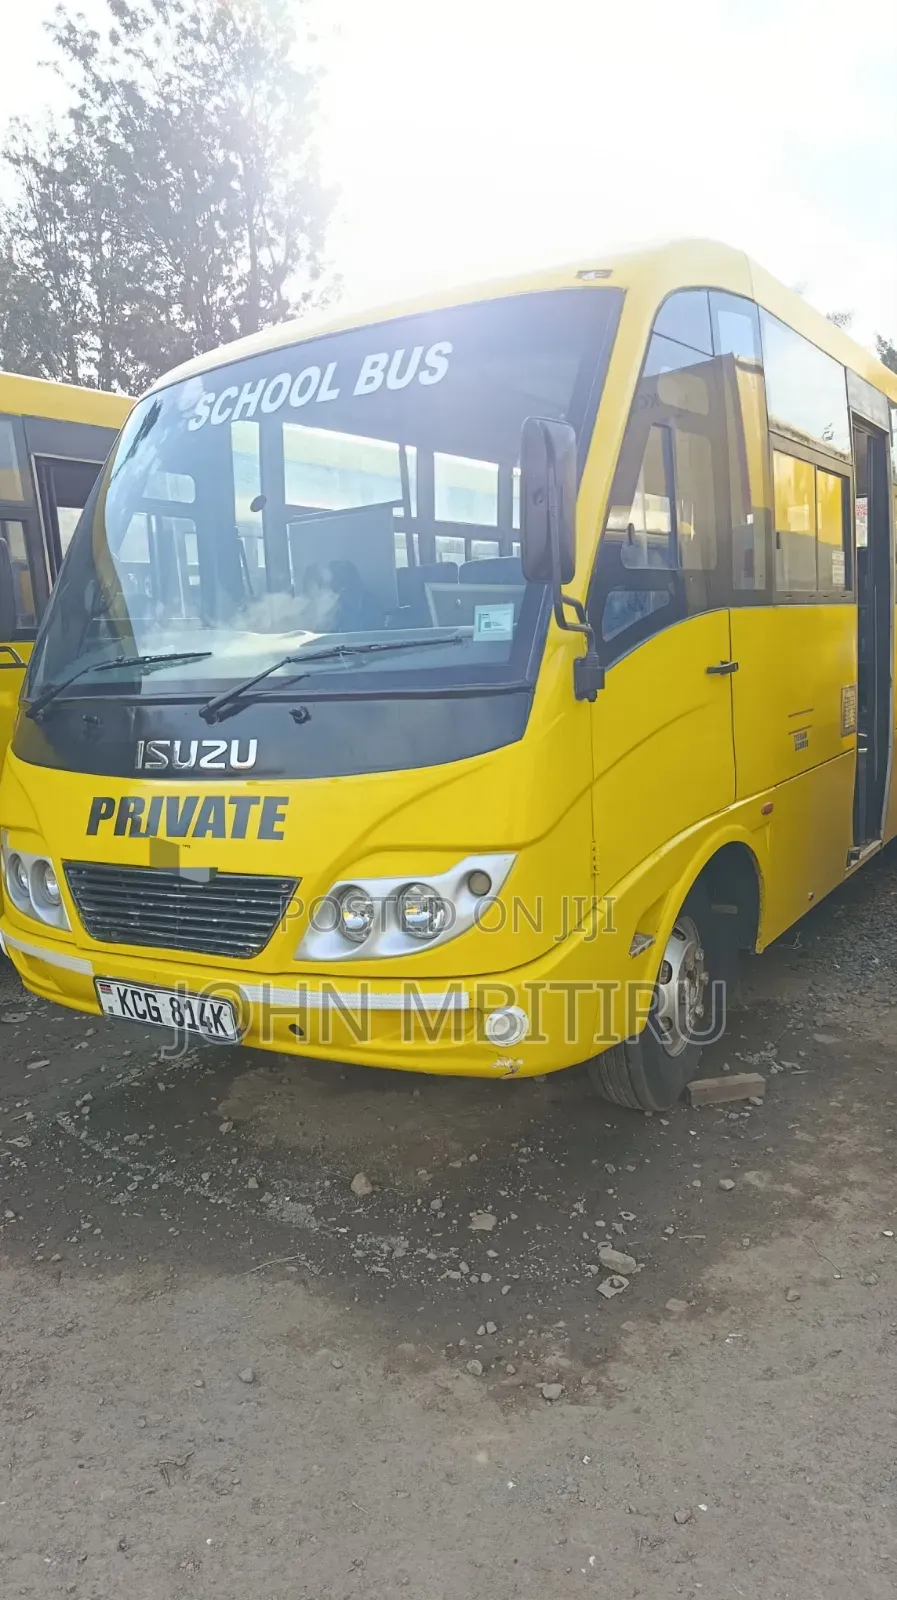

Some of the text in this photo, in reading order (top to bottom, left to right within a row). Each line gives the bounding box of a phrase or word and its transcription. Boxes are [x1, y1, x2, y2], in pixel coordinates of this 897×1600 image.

[188, 341, 453, 431] SCHOOL BUS
[134, 739, 258, 770] ISUZU
[86, 796, 290, 841] PRIVATE
[116, 986, 229, 1037] KCG 814K
